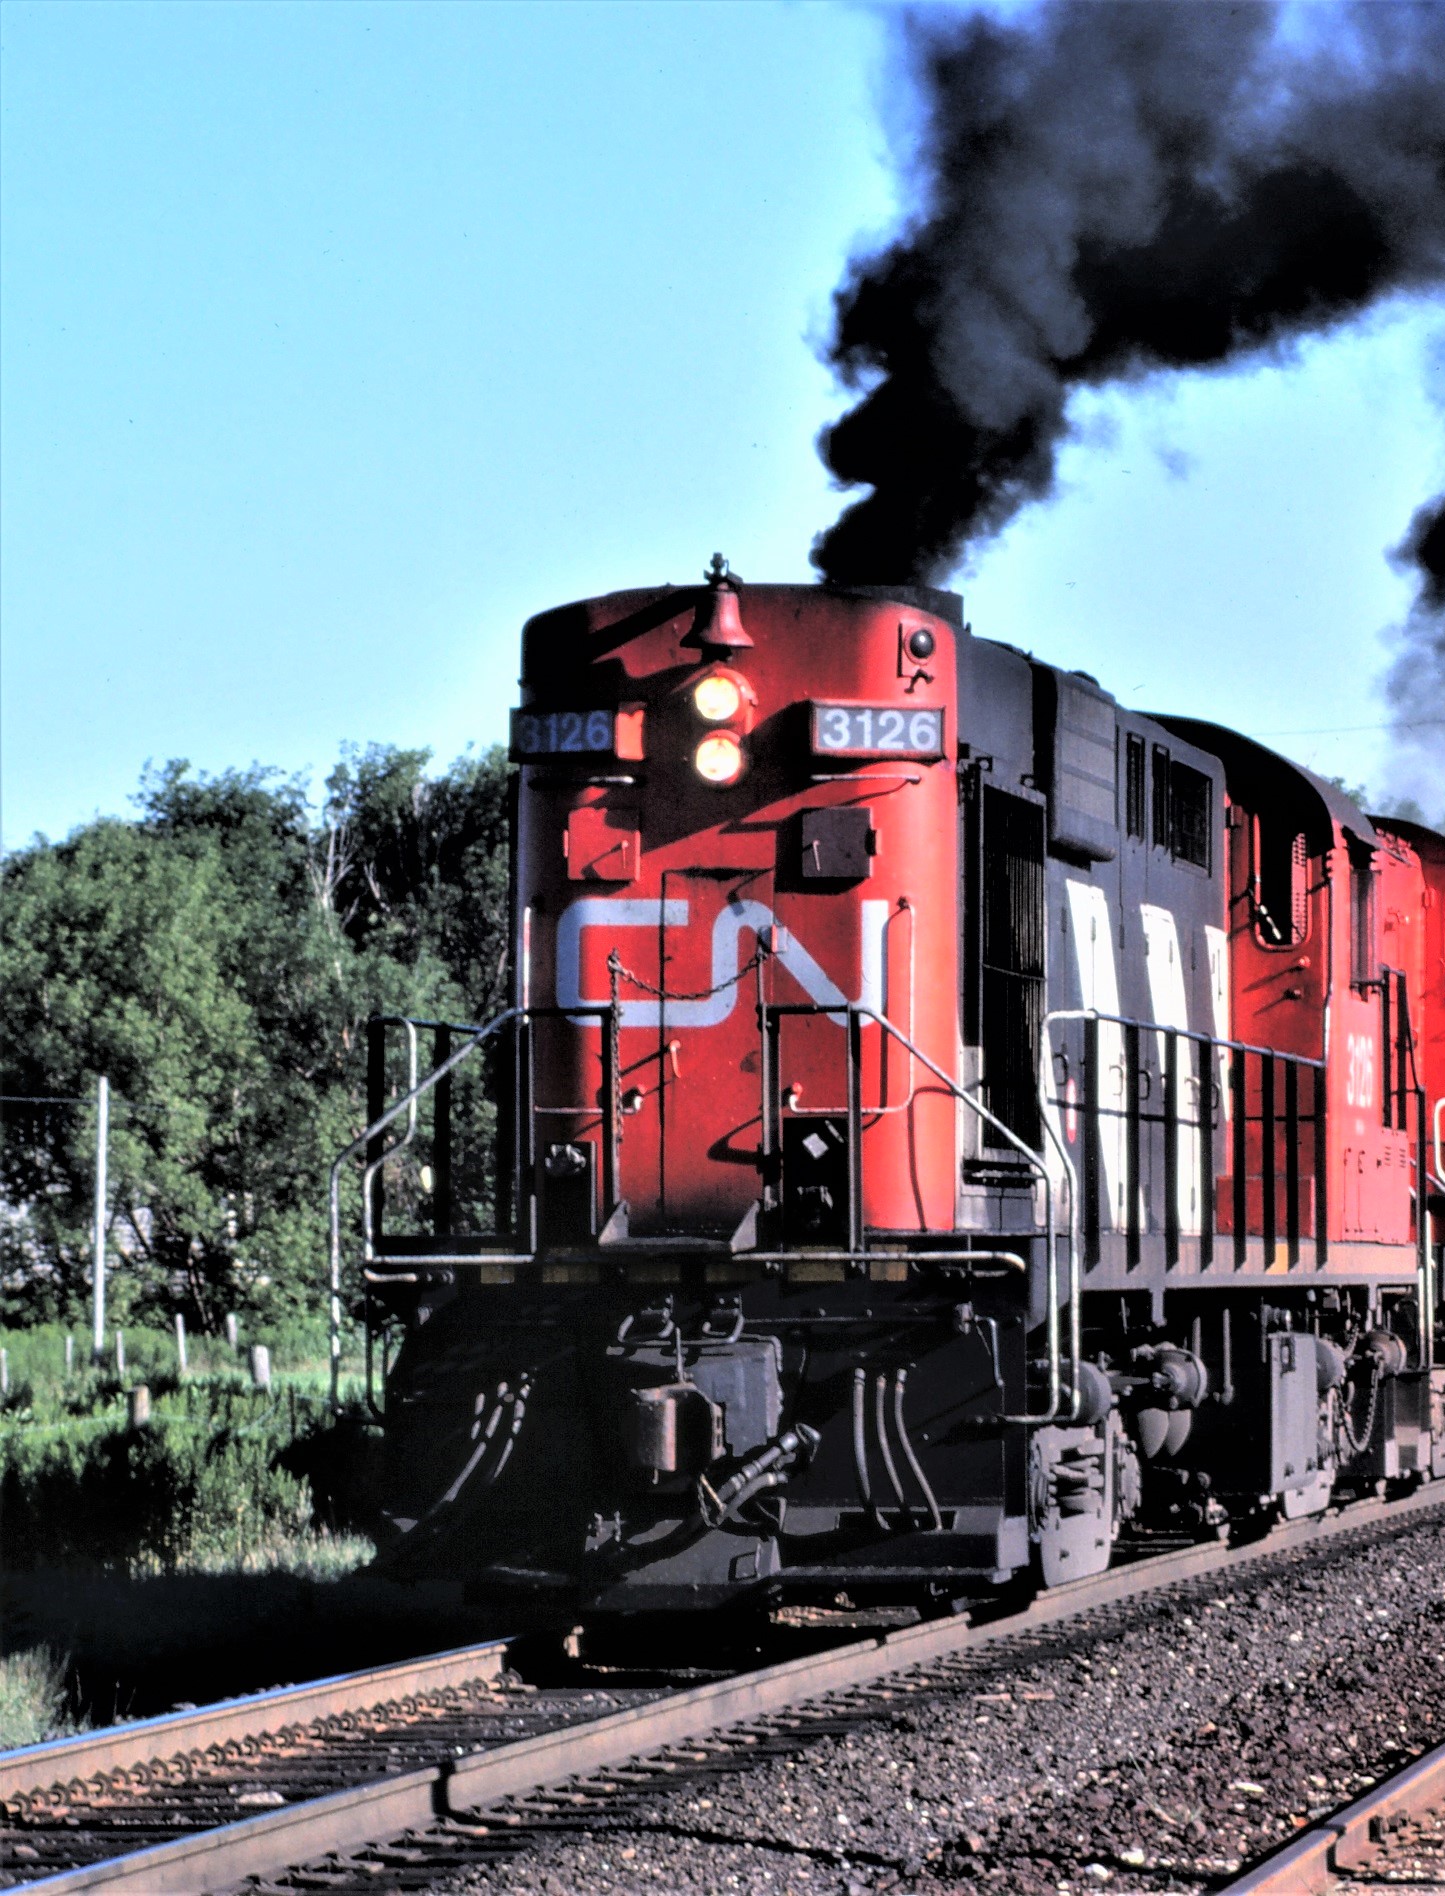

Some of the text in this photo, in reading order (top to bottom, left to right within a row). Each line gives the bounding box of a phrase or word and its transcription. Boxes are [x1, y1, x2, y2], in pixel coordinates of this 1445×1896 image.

[520, 710, 611, 753] 3126
[823, 708, 937, 750] 3126
[557, 900, 888, 1026] CN
[1347, 1033, 1373, 1107] 3126
